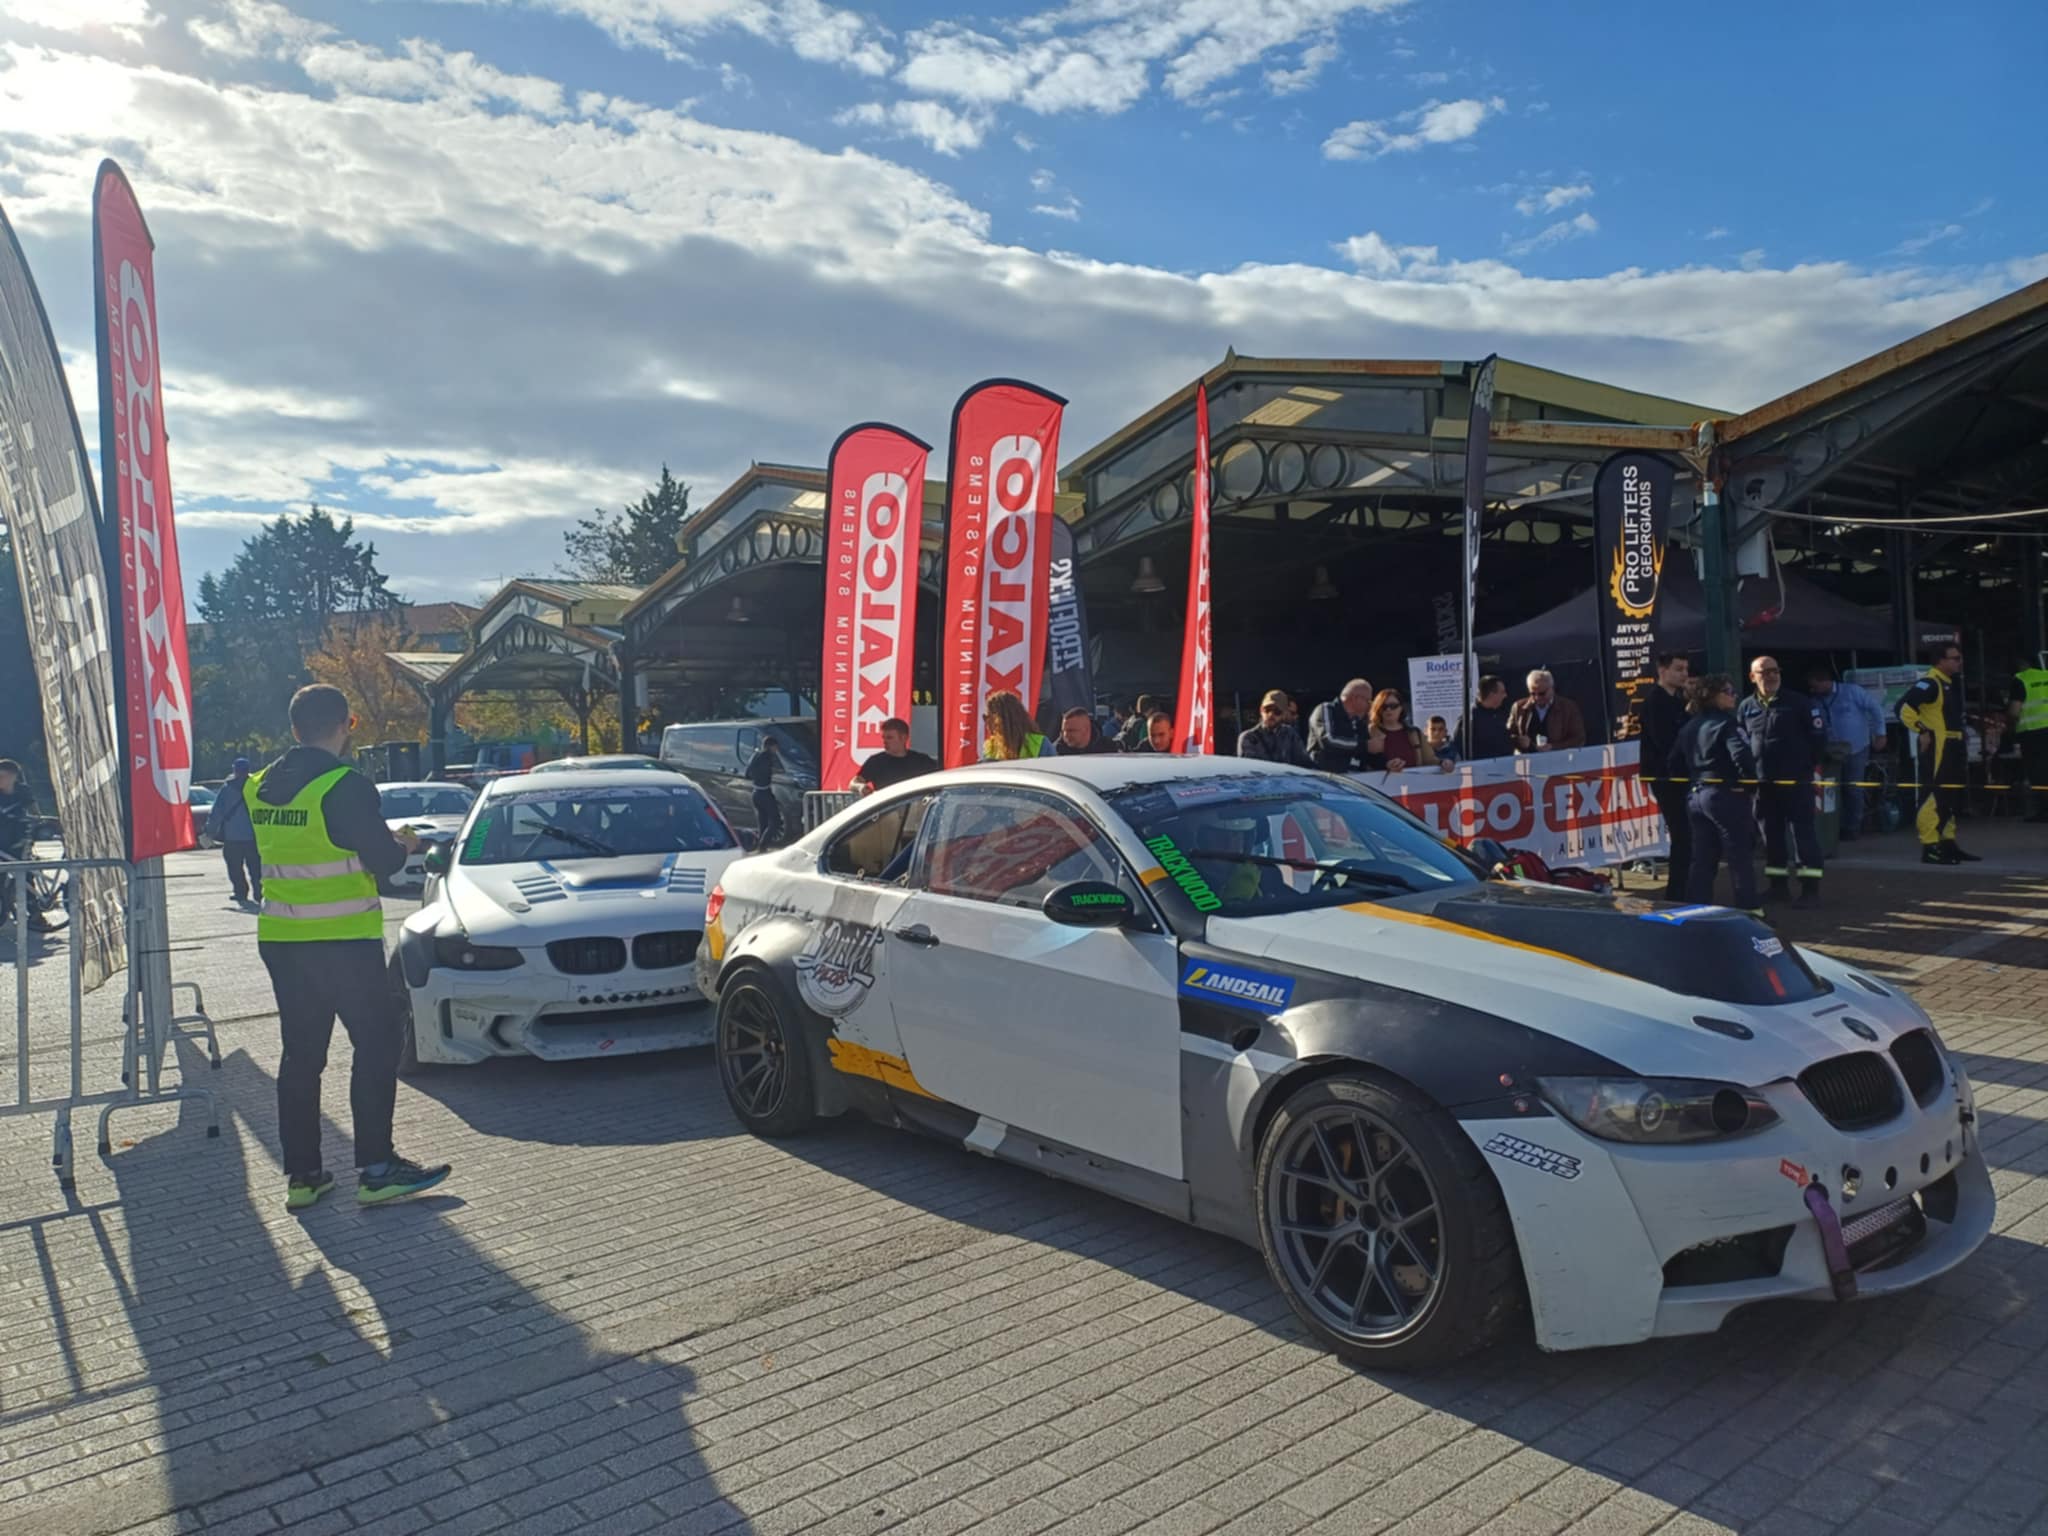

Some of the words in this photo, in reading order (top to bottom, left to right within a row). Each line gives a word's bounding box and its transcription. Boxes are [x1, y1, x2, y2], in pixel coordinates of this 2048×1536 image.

[1622, 465, 1640, 545] LIFTERS
[1639, 481, 1654, 578] GEORGIADIS
[1625, 551, 1641, 593] PRO
[1070, 893, 1126, 907] TRACKWOOD
[1145, 834, 1224, 913] TRACKWOOD
[1184, 967, 1285, 1004] LANDSAIL
